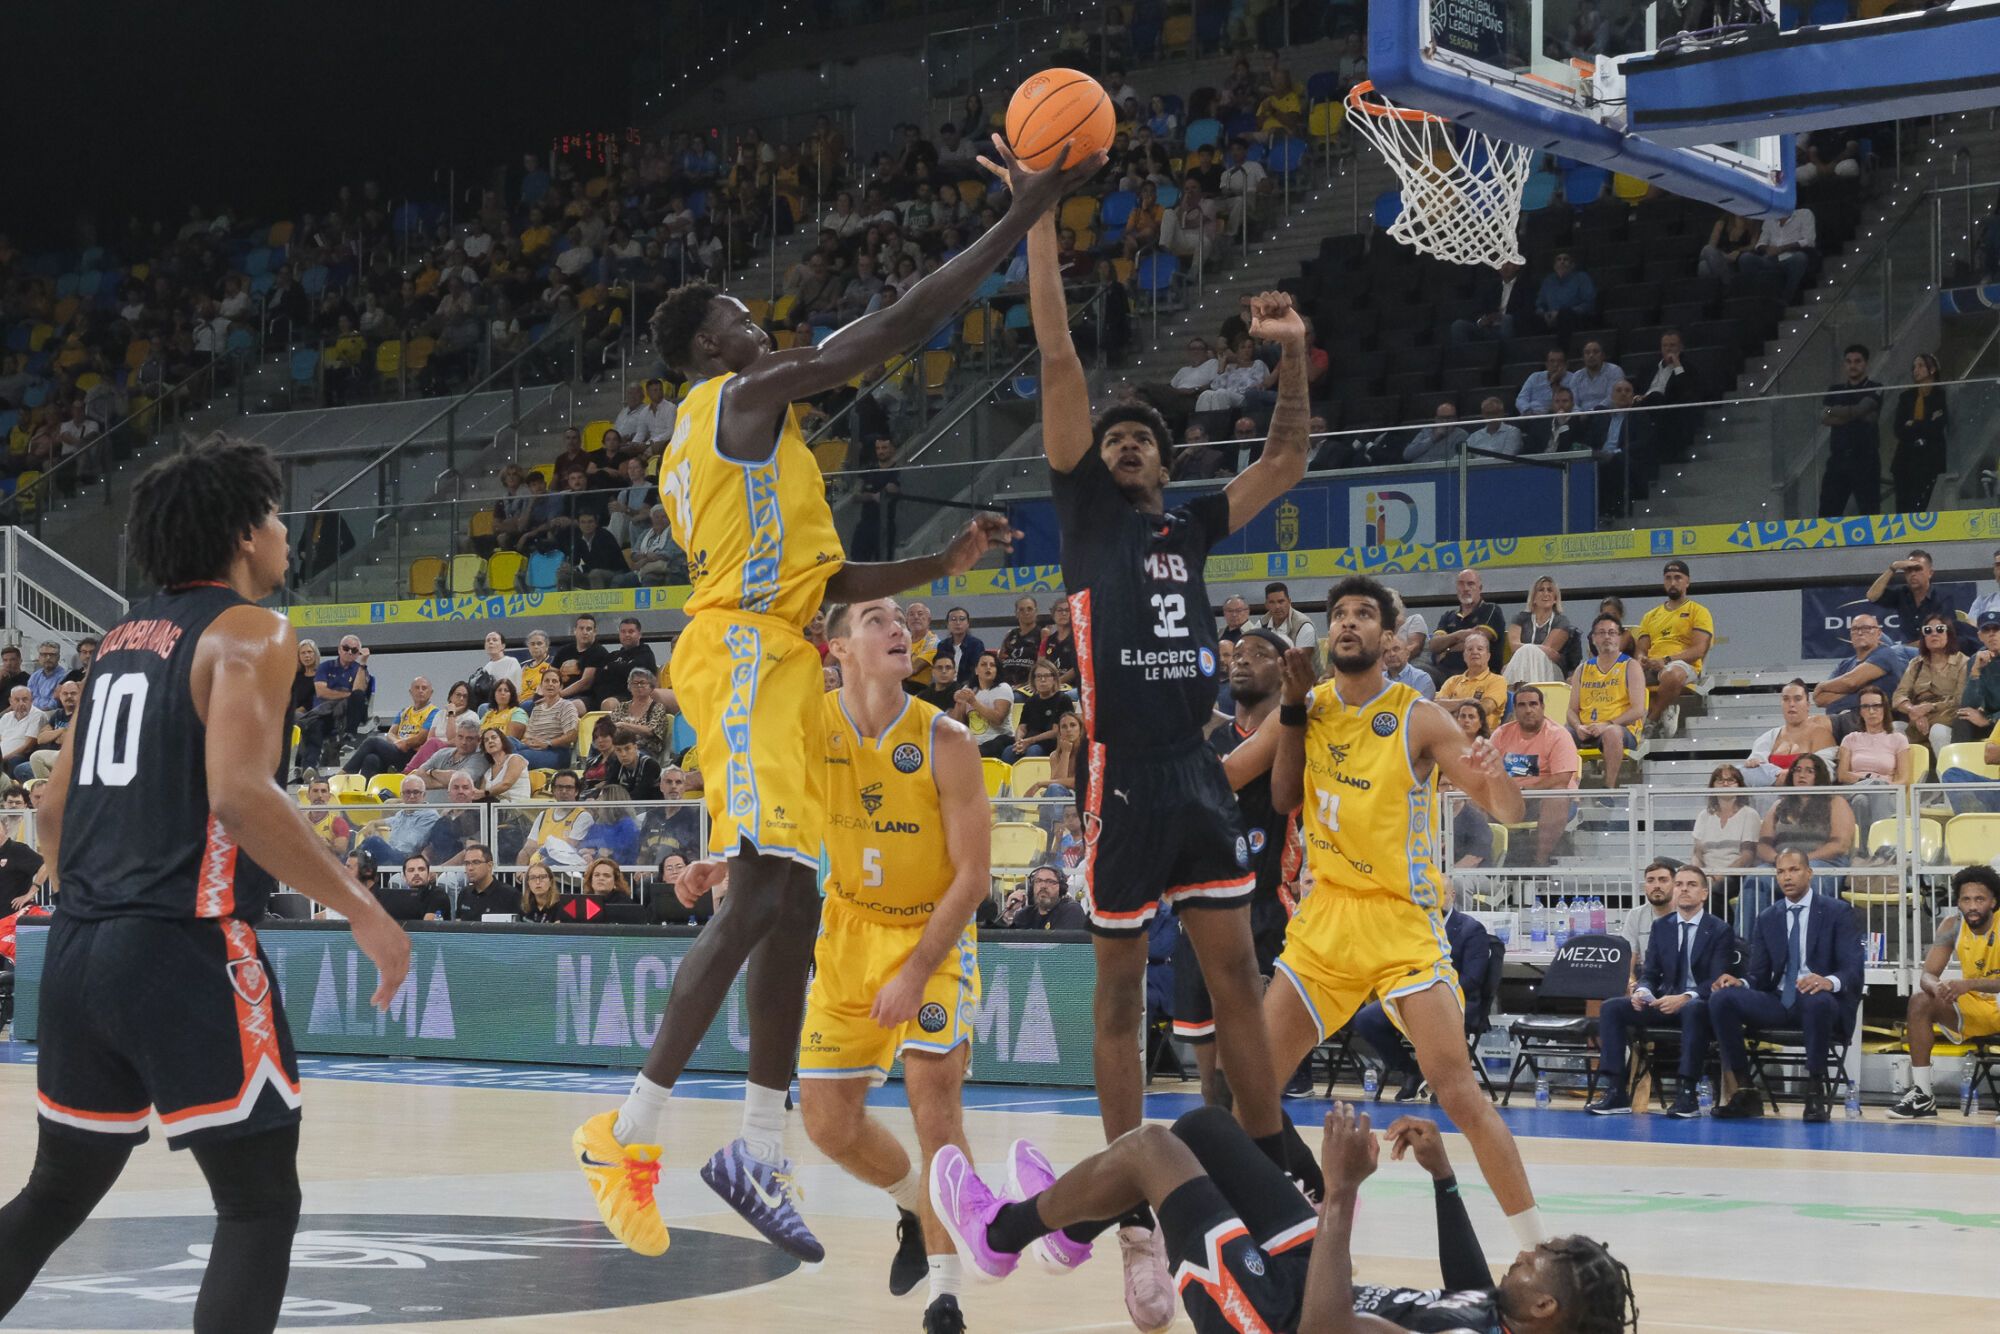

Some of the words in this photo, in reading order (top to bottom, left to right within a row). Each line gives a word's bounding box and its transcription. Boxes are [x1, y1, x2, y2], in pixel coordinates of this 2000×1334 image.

[1448, 3, 1504, 34] CHAMPIONS
[1448, 17, 1479, 38] LEAGUE
[1449, 34, 1473, 50] SEASON
[1151, 593, 1190, 638] 32
[1145, 667, 1160, 681] LE
[78, 672, 150, 787] 10
[863, 847, 883, 887] 5
[1557, 946, 1622, 963] MEZZO
